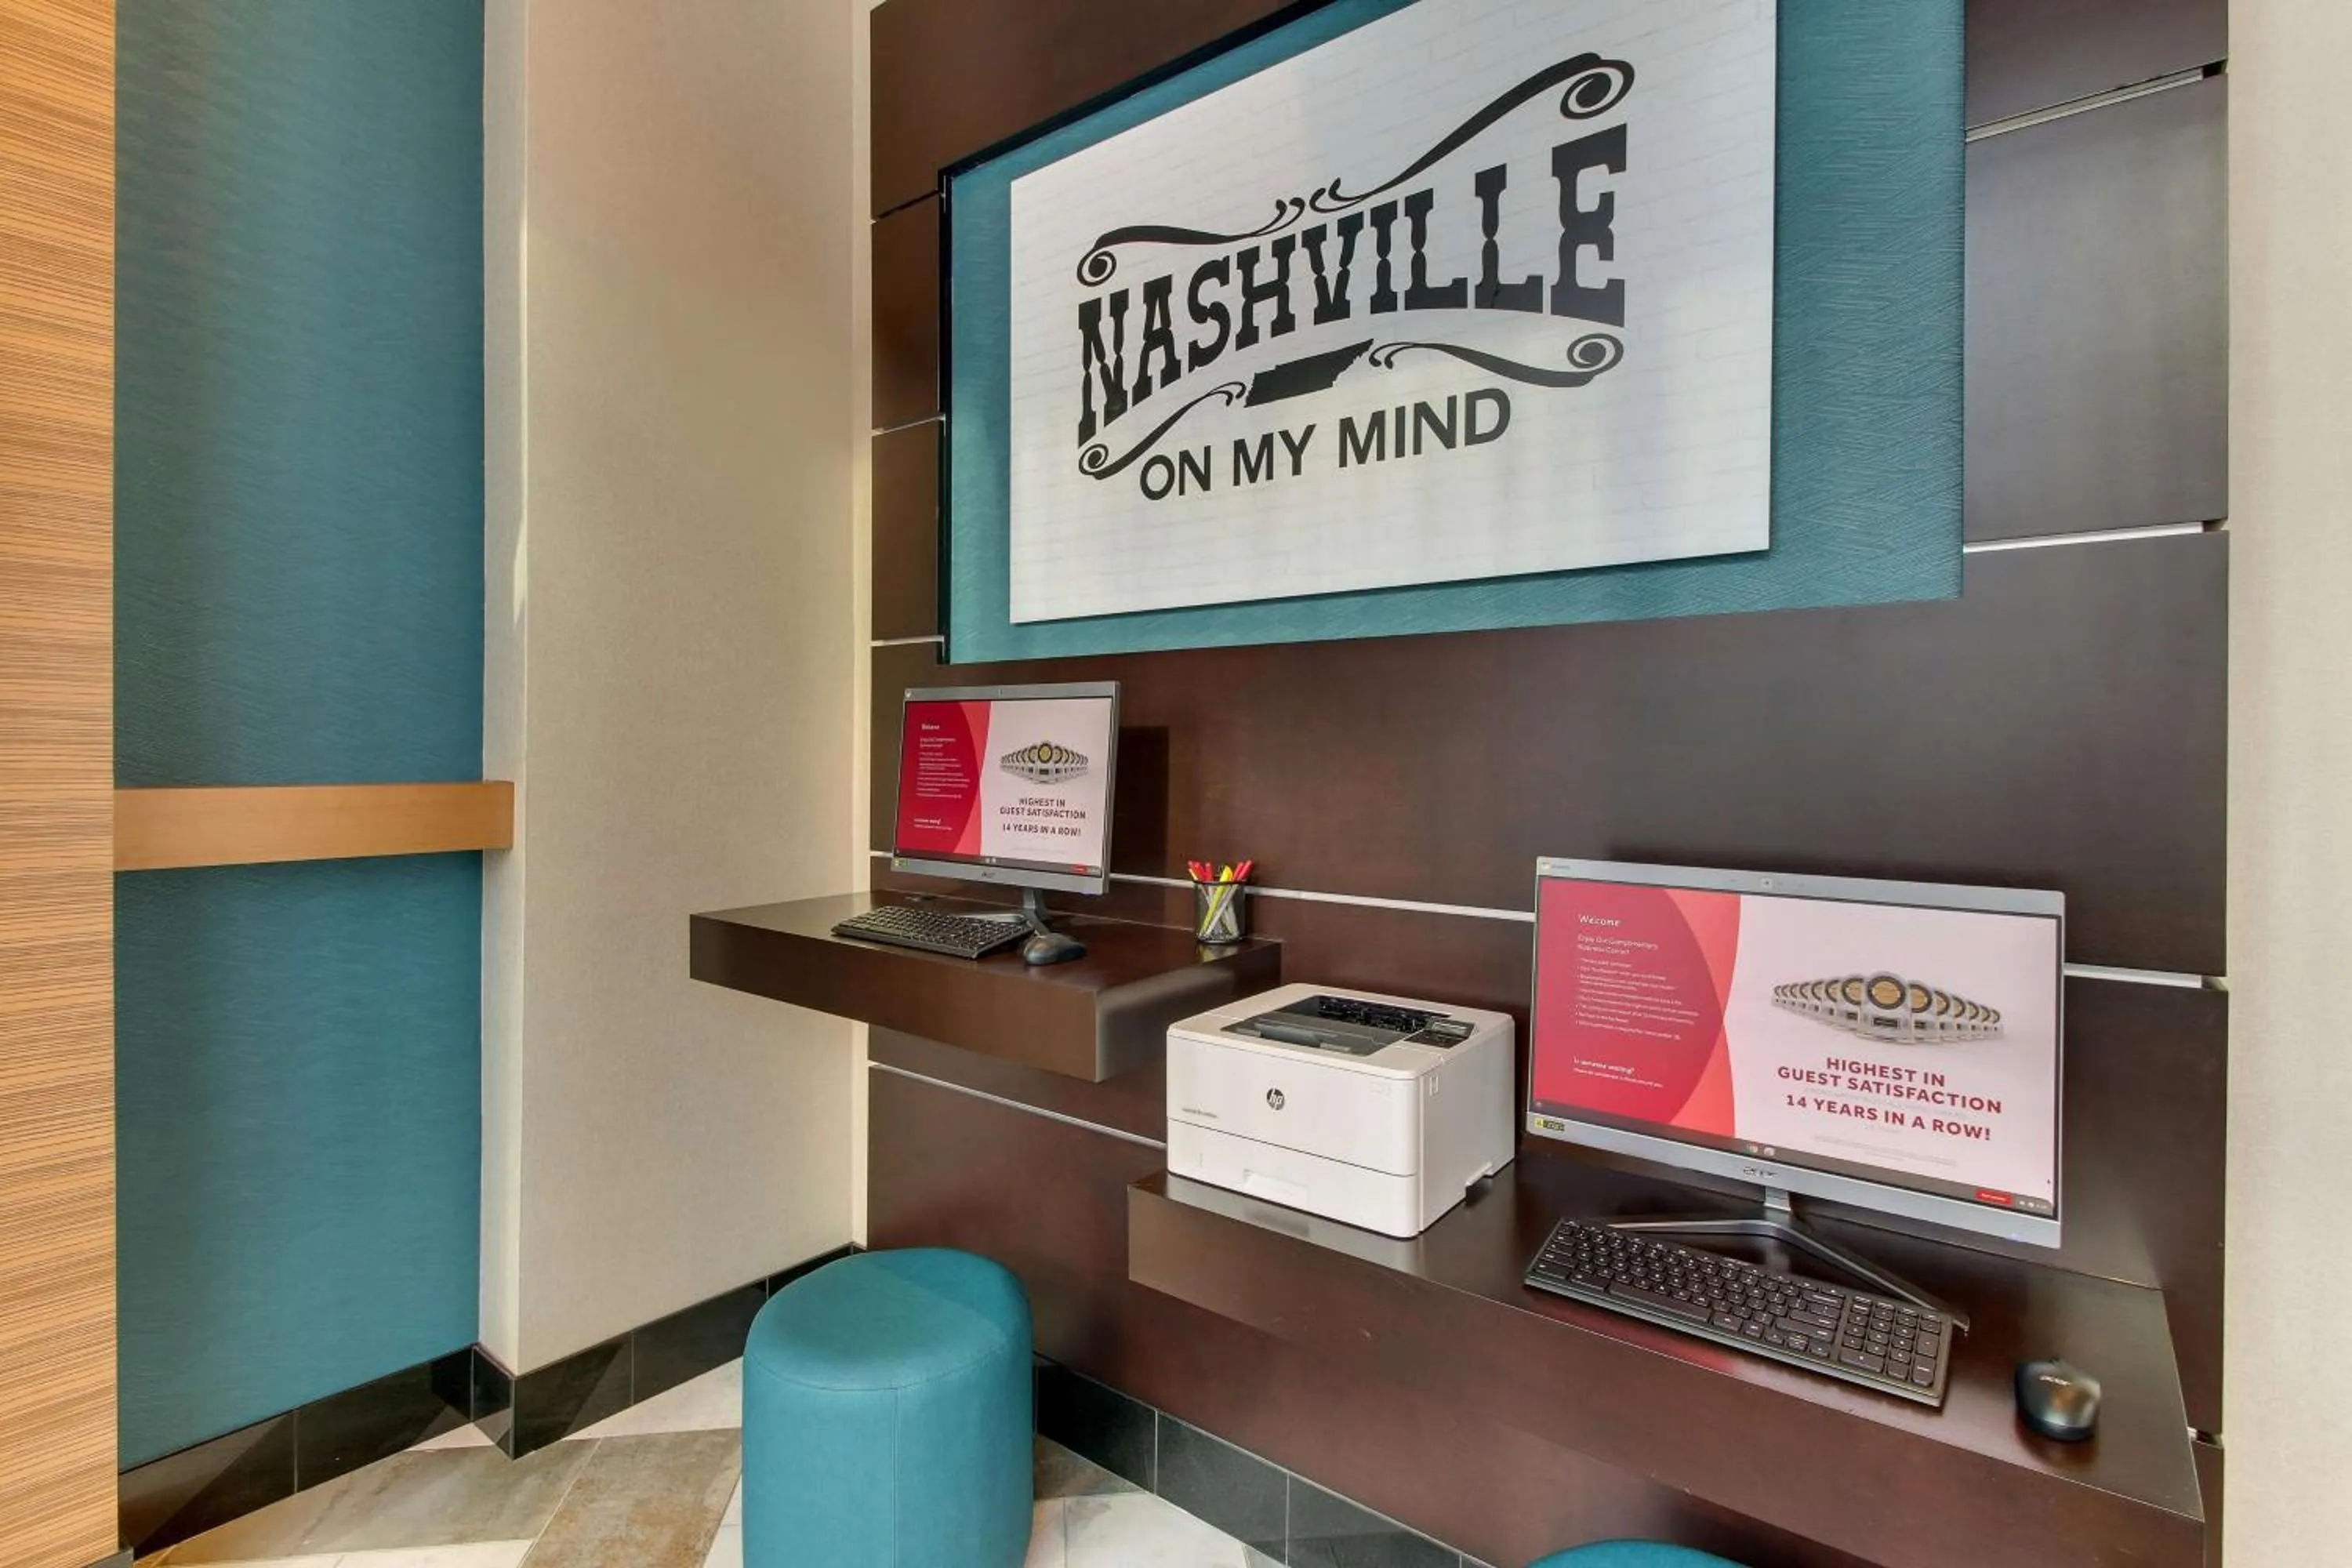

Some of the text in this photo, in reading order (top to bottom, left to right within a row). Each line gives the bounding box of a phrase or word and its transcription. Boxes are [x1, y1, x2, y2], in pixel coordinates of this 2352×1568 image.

[1078, 122, 1627, 448] NASHVILLE
[1140, 388, 1511, 500] ON MY MIND
[1000, 806, 1086, 818] GUEST SATISFACTION
[1056, 798, 1065, 808] IN
[1013, 824, 1039, 833] YEARS
[1051, 826, 1056, 835] A
[1826, 1057, 1945, 1087] HIGHEST IN
[1267, 1087, 1285, 1110] hp
[1777, 1066, 2002, 1113] GUEST SATISFACTION
[1787, 1094, 1991, 1140] 14 YEARS IN A ROW!
